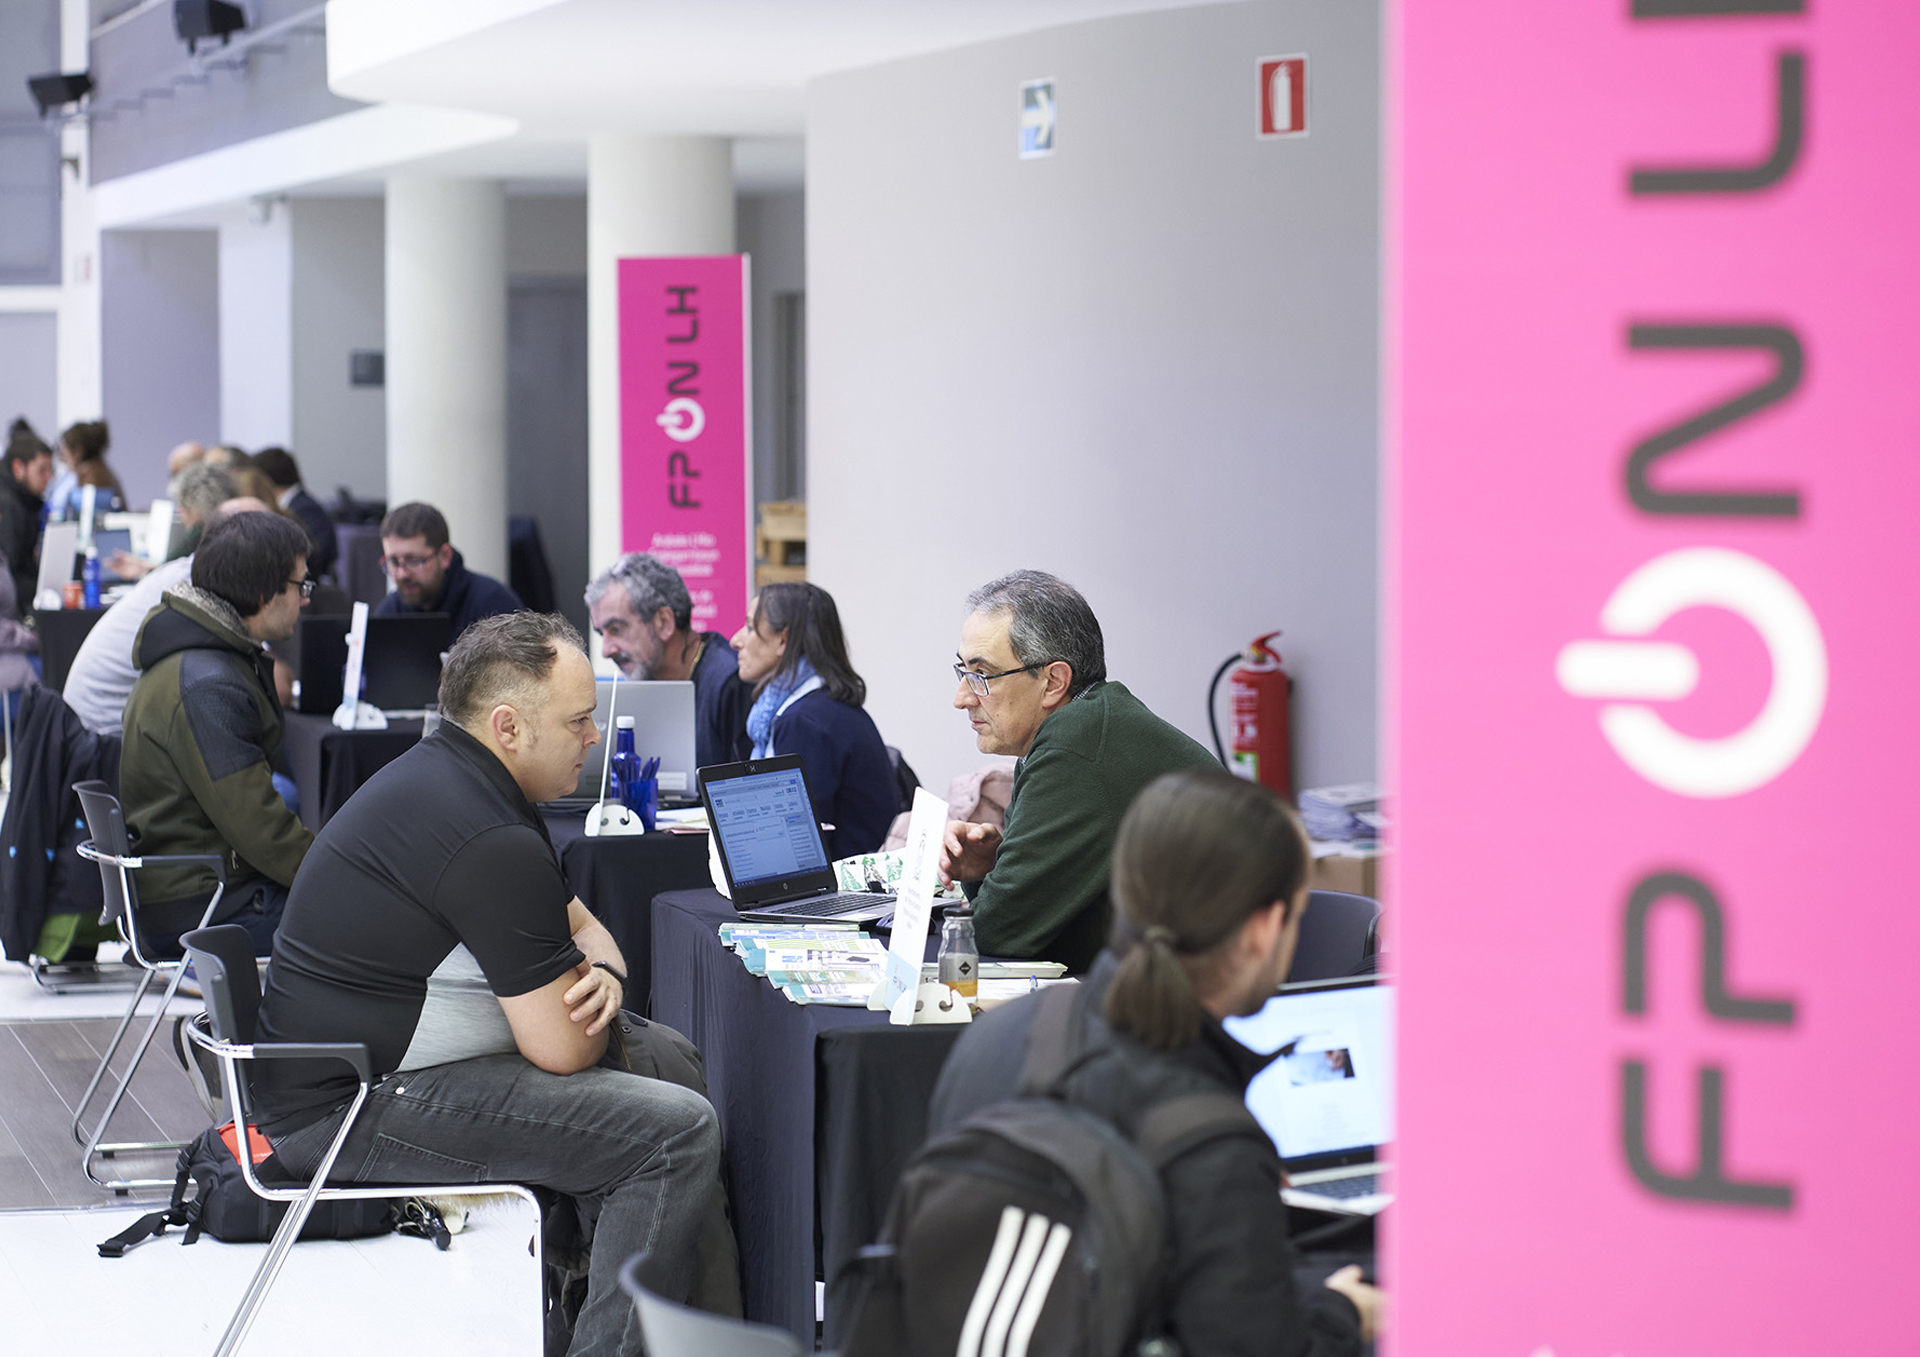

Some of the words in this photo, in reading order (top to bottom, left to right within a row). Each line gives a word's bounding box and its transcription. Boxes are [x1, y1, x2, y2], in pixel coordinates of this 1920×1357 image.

[1624, 0, 1810, 197] L
[667, 286, 698, 343] LH
[668, 451, 700, 508] FP
[1619, 868, 1800, 1214] FP
